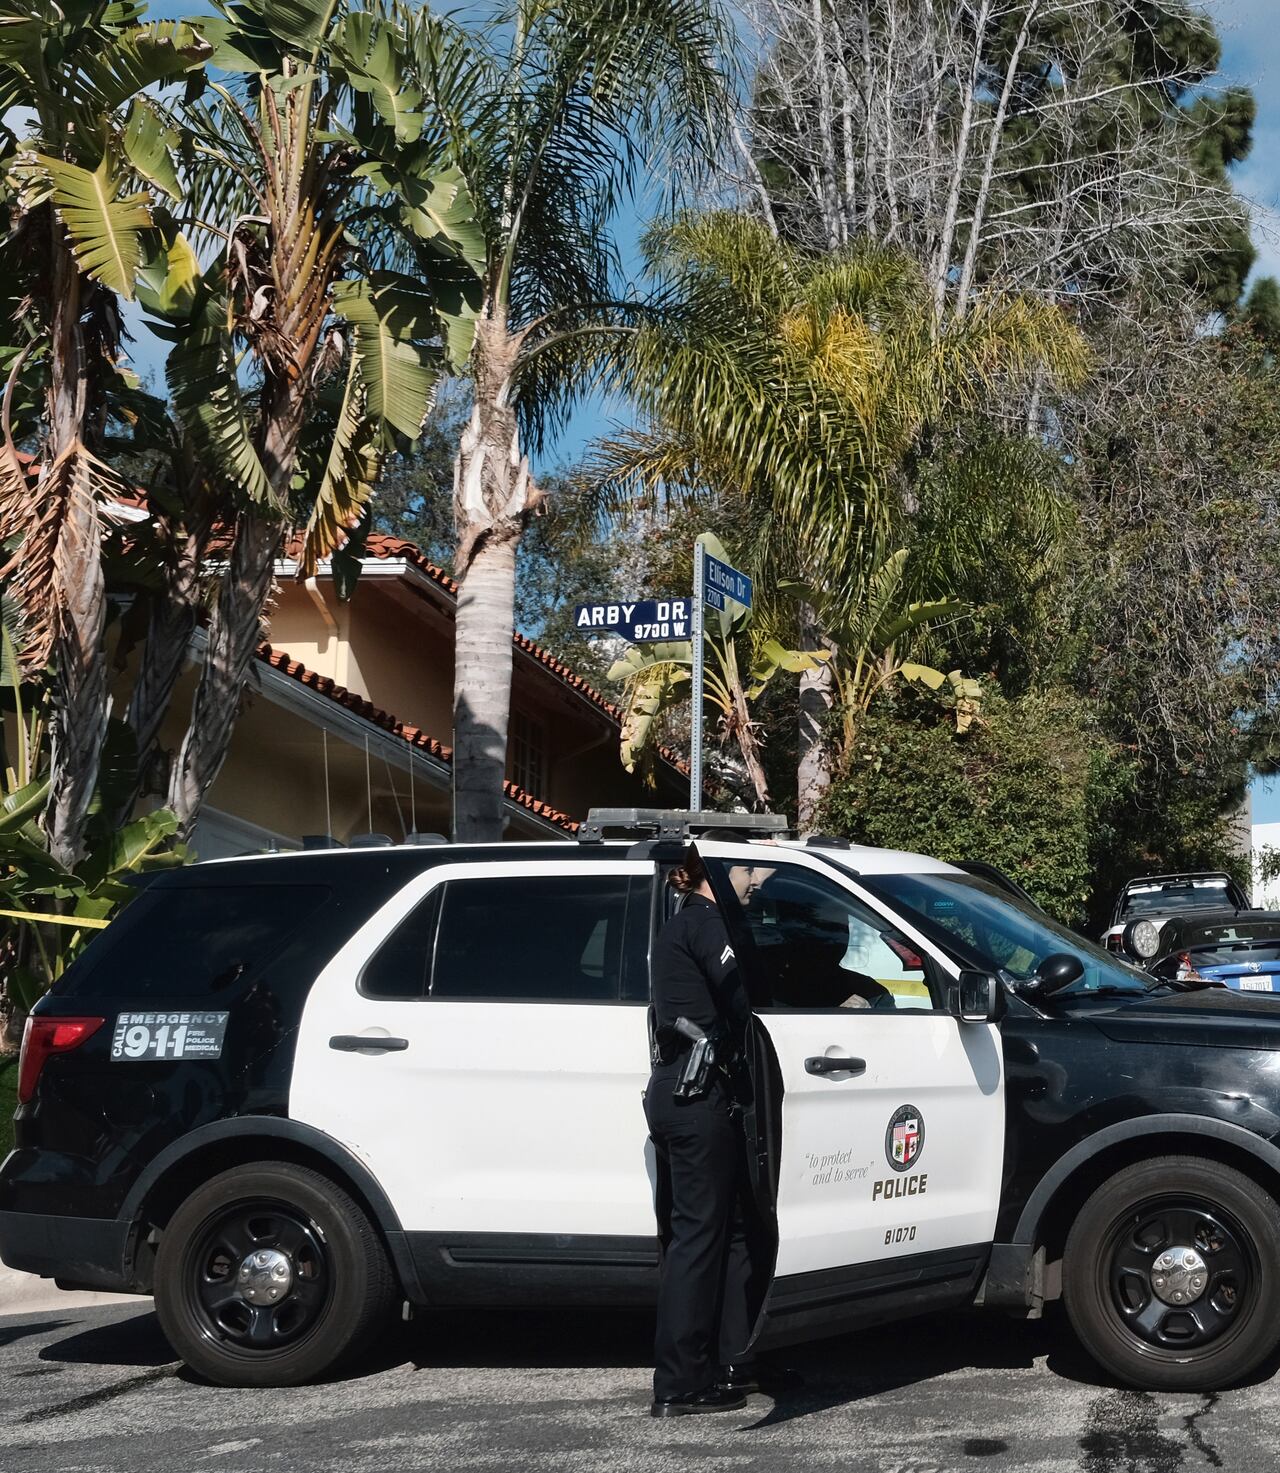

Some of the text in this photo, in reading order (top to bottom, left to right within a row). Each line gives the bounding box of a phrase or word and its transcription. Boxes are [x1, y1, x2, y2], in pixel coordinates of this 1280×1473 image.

[709, 560, 746, 599] Ellison Dr
[577, 601, 689, 627] ARBY DR.
[673, 622, 686, 637] W.
[118, 1014, 228, 1024] EMERGENCY
[112, 1025, 127, 1057] CALL
[124, 1025, 188, 1058] 9-1-1
[819, 1148, 853, 1171] protect
[812, 1167, 833, 1185] and
[833, 1168, 844, 1183] to
[872, 1173, 928, 1202] POLICE
[884, 1225, 917, 1245] 81070
